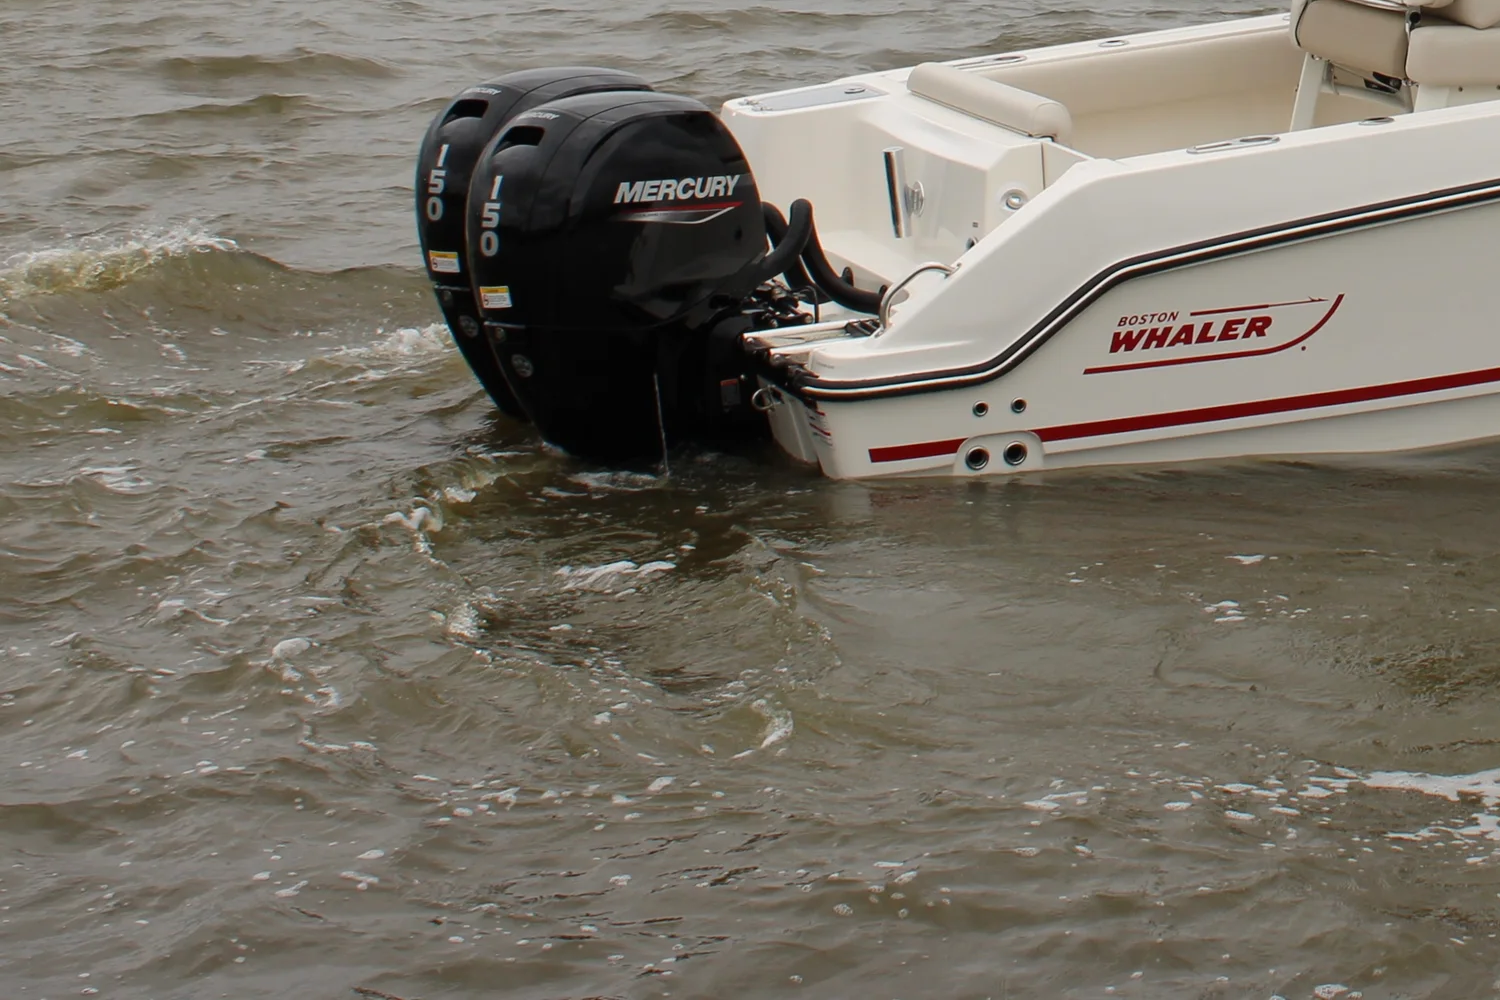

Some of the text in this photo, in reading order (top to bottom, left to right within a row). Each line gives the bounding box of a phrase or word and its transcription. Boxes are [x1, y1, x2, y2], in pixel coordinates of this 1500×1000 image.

[612, 174, 740, 204] MERCURY
[1117, 311, 1180, 327] BOSTON
[1109, 316, 1273, 354] WHALER
